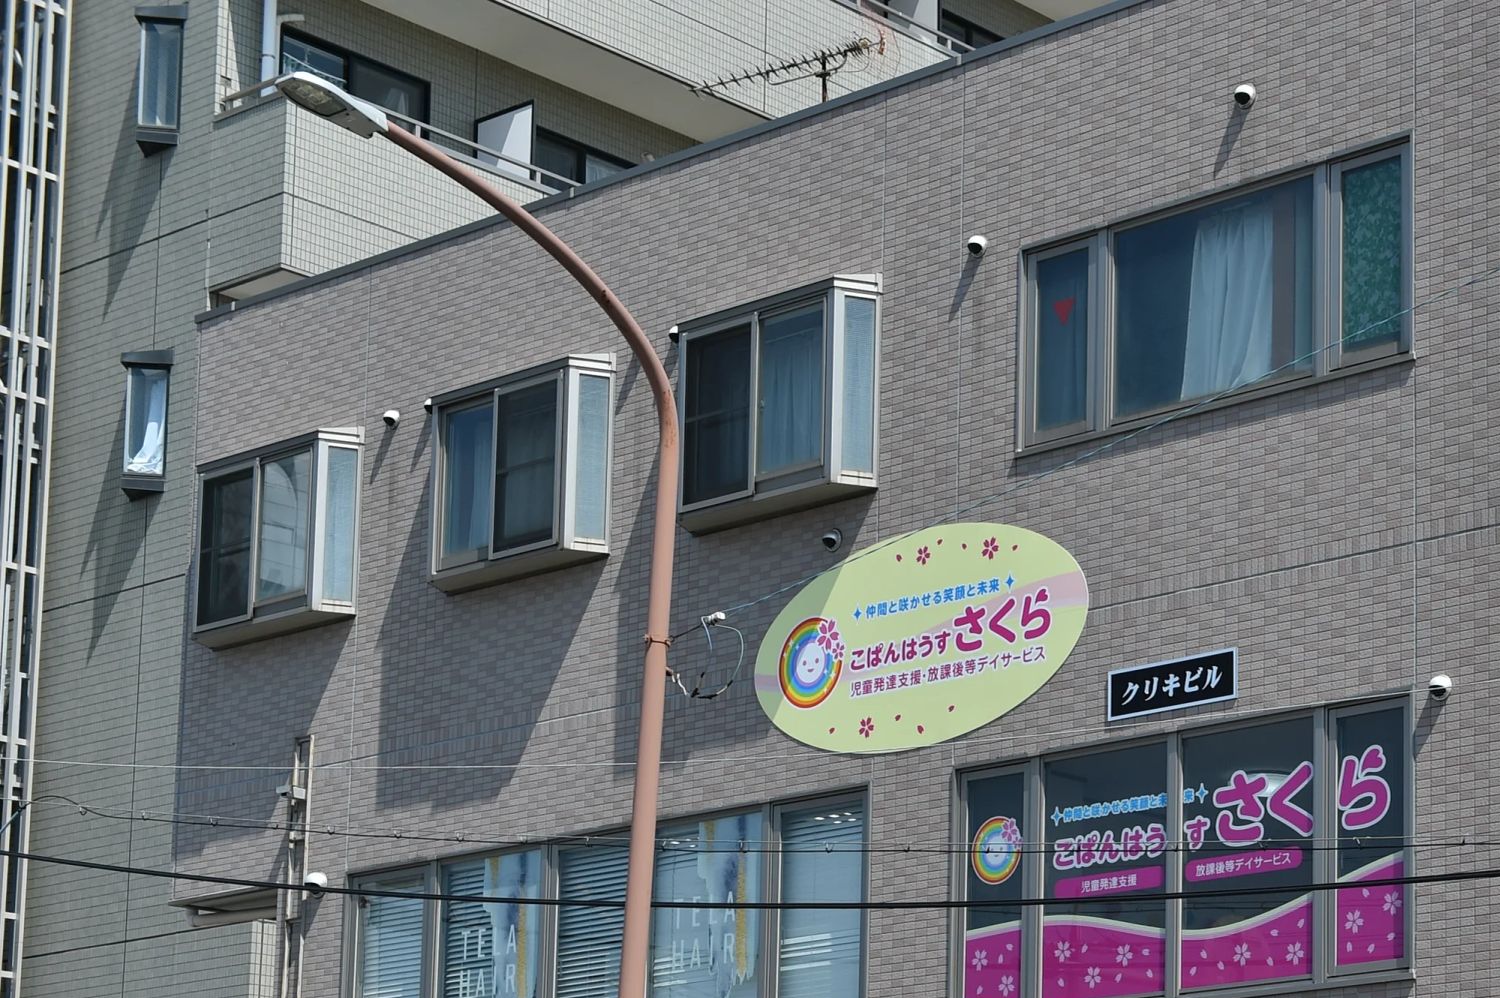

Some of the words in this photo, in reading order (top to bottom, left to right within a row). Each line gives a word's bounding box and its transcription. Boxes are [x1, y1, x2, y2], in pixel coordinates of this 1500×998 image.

[866, 577, 1000, 619] 仲間と咲かせる笑顔と未来
[850, 646, 1046, 698] 児童発達支援・放課後等デイサービス
[1121, 665, 1222, 706] クリキビル
[1195, 850, 1292, 878] 放課後等デイサービス
[1081, 873, 1137, 893] 児童発達支援
[673, 891, 735, 929] TELA
[461, 924, 517, 960] TELA
[672, 933, 735, 970] HAIR
[459, 964, 516, 998] HAIR
